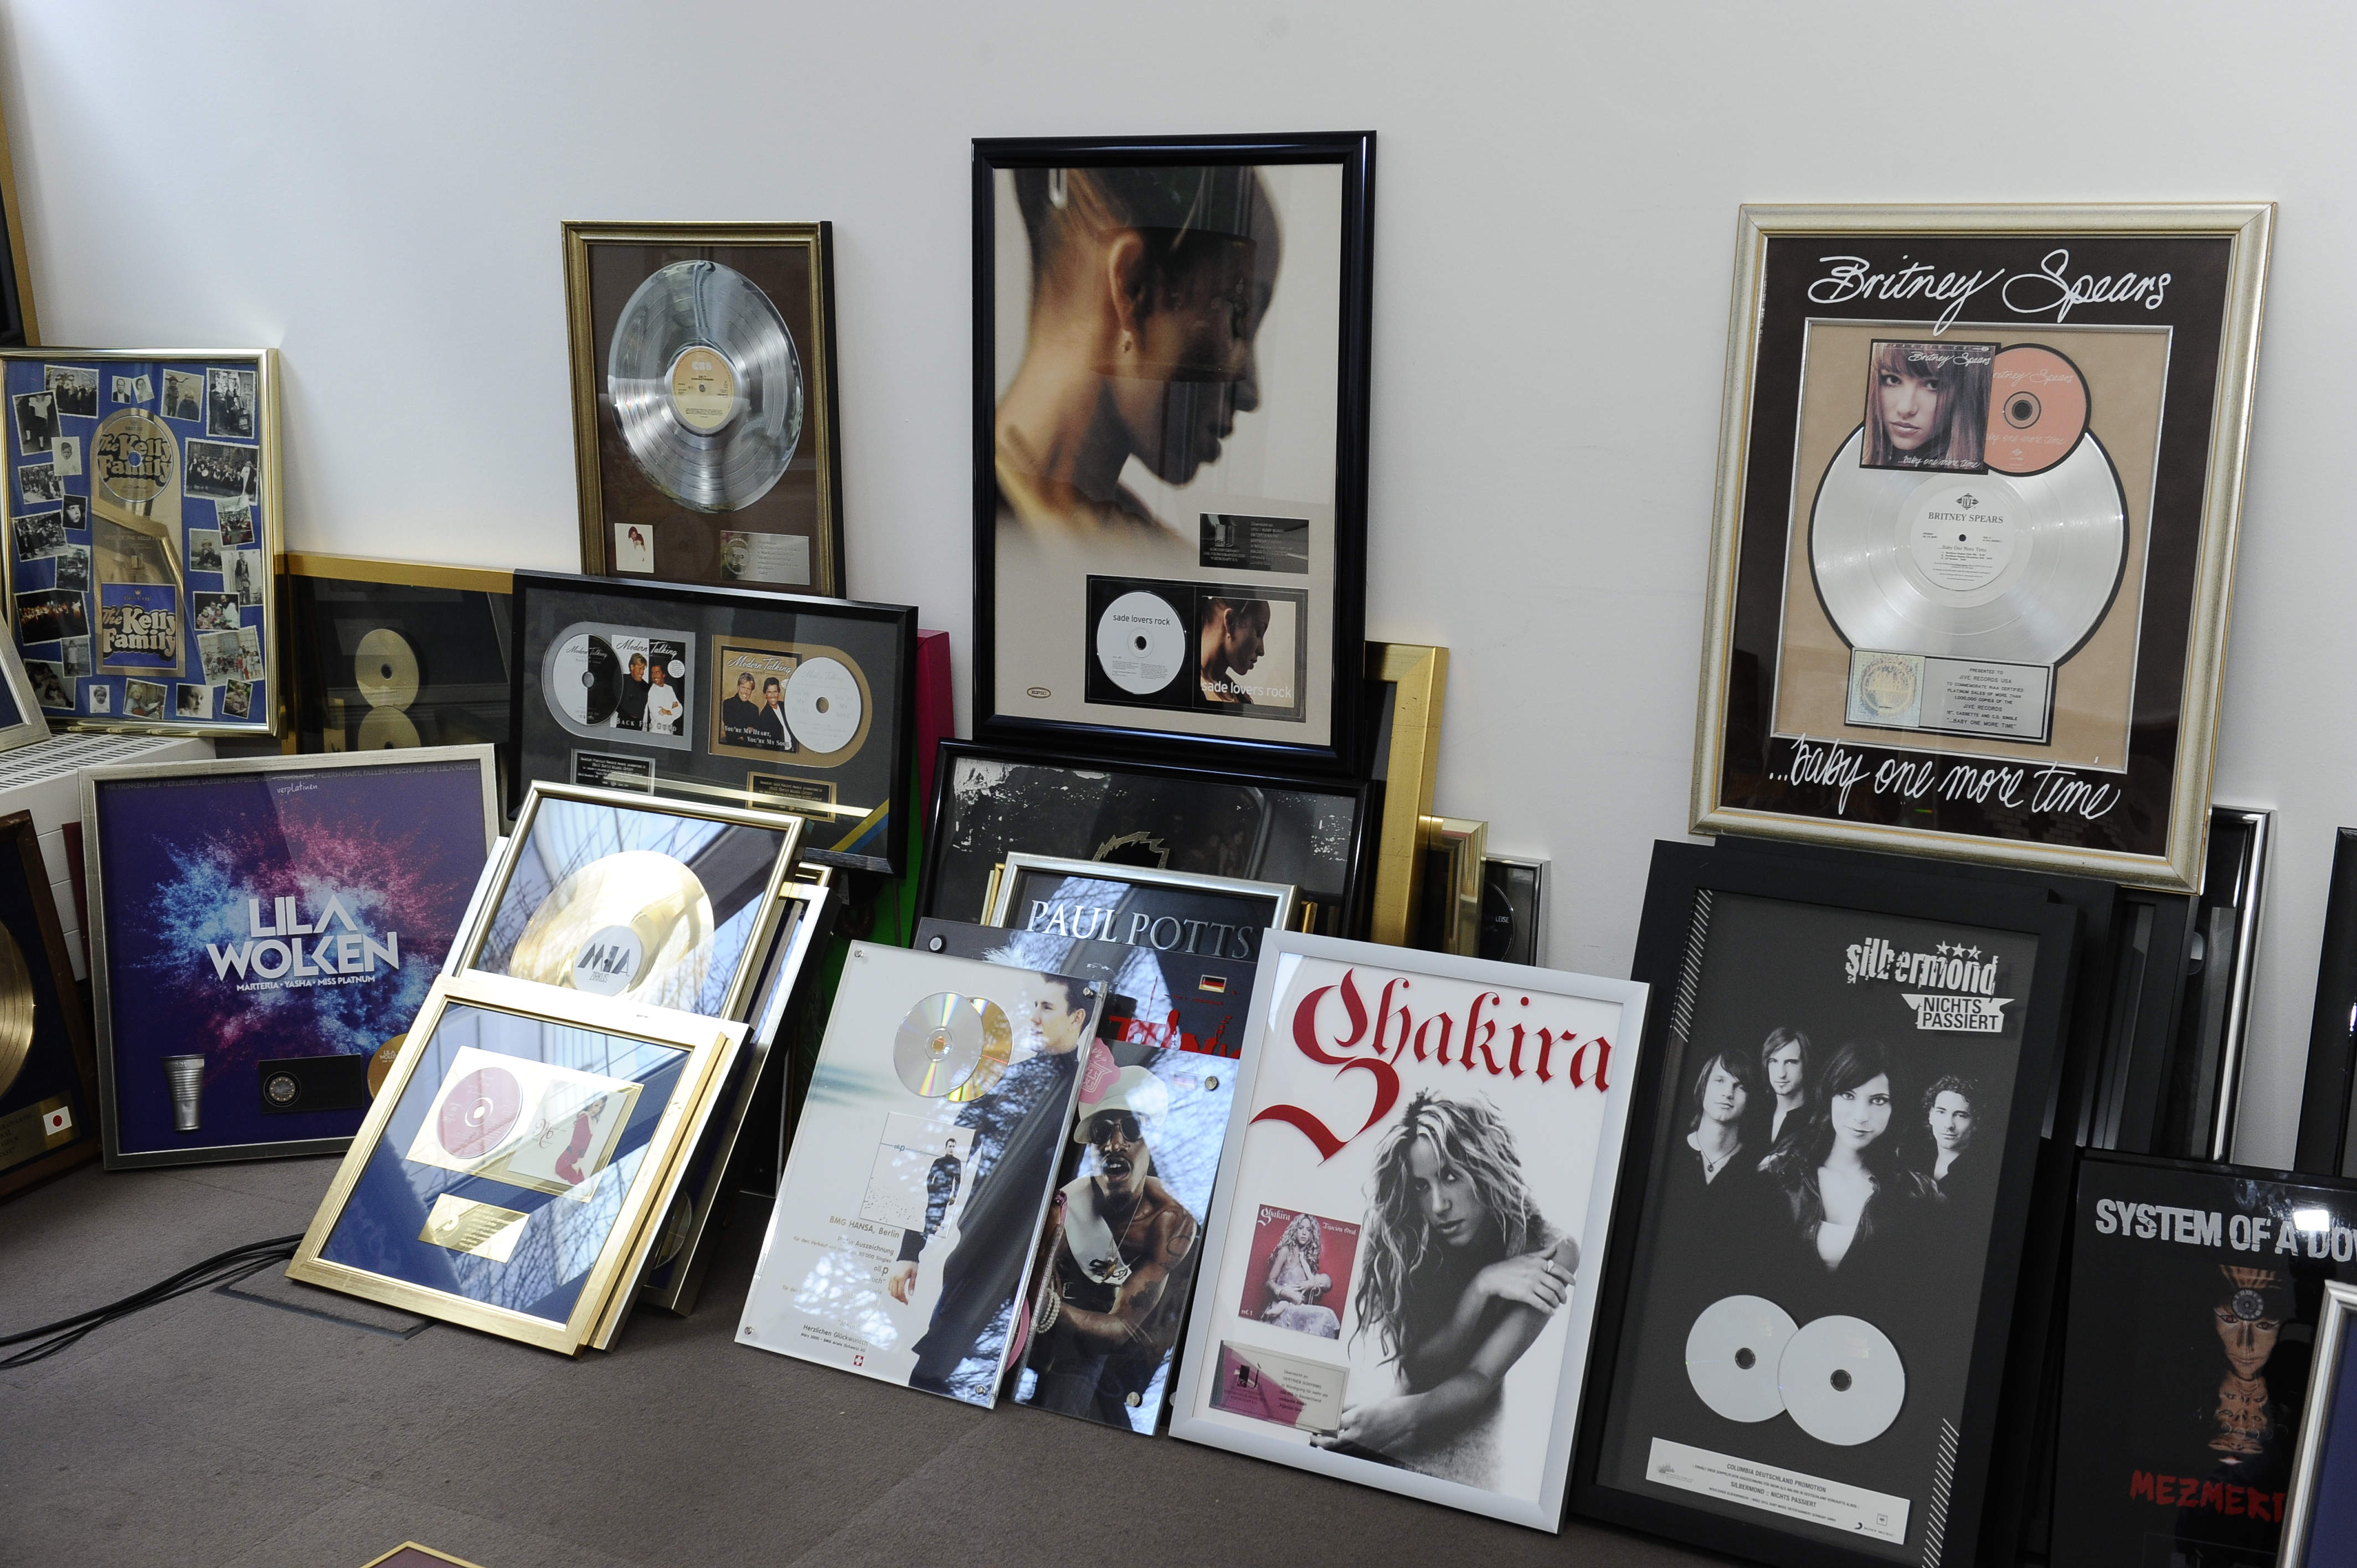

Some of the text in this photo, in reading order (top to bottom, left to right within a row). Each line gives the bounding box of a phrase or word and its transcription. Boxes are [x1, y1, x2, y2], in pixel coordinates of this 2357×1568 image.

[1808, 249, 2171, 337] Britney Spears
[1908, 351, 1991, 368] Britney Spears
[1993, 369, 2073, 386] ritney Spears
[118, 434, 171, 461] Kelly
[1960, 458, 1981, 468] time
[1928, 512, 2004, 523] BRITNEY SPEARS
[102, 607, 176, 635] The Kelly
[1131, 615, 1153, 624] lovers
[103, 628, 176, 657] Family
[567, 645, 588, 654] Modern
[616, 638, 678, 659] Modern Talking
[727, 656, 792, 677] Modern Talking
[1201, 681, 1292, 698] sade lovers rock
[616, 718, 635, 726] BACK
[363, 768, 388, 777] FALLEN
[388, 767, 411, 775] WEICH
[277, 782, 318, 795] verplatinen
[1874, 758, 1935, 798] one
[1938, 765, 2024, 808] more
[2030, 755, 2121, 820] time
[249, 894, 358, 937] LILA
[1025, 899, 1253, 960] PAUL POTTS
[206, 931, 399, 981] WOLKEN
[1845, 937, 1999, 996] silbermond
[236, 975, 375, 991] MARTERIA YASHA MISS PLATNUM
[1923, 997, 1982, 1014] NICHTS
[1922, 1012, 1999, 1030] PASSIERT
[1248, 967, 1613, 1167] Shakira
[1257, 1207, 1291, 1226] Shakira
[829, 1216, 899, 1239] BMG HANSA, Berlin
[2096, 1198, 2357, 1262] SYSTEM OF A DO
[855, 1241, 894, 1255] Auszeichnung
[803, 1324, 868, 1347] Herzlichen Glückwunsch
[1726, 1463, 1754, 1475] COLUMBIA
[1755, 1471, 1794, 1485] DEUTSCHLAND
[1794, 1480, 1826, 1493] PROMOTION
[1730, 1481, 1765, 1495] SILBERMOND
[1771, 1491, 1790, 1502] NICHTS
[1790, 1496, 1817, 1508] PASSIERT
[2130, 1469, 2287, 1523] MEZMERI
